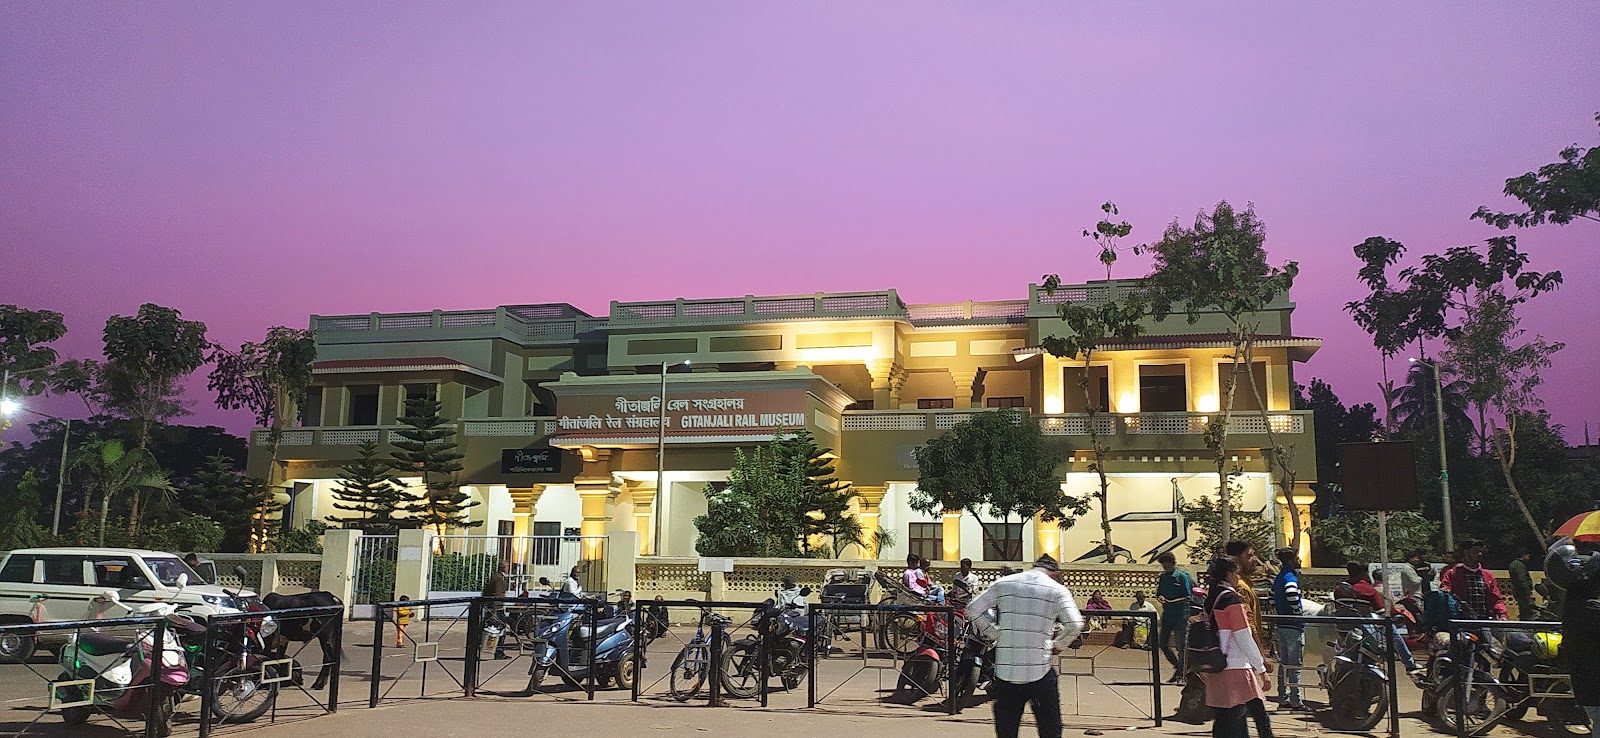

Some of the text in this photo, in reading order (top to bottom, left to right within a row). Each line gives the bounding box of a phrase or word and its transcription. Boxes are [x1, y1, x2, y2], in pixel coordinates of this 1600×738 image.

[667, 399, 690, 411] রেল
[691, 397, 745, 411] সংগ্রহালয়
[558, 414, 602, 430] गीतांजलि
[605, 414, 622, 429] रेल
[681, 413, 804, 428] GITANJALI RAIL MUSEUM
